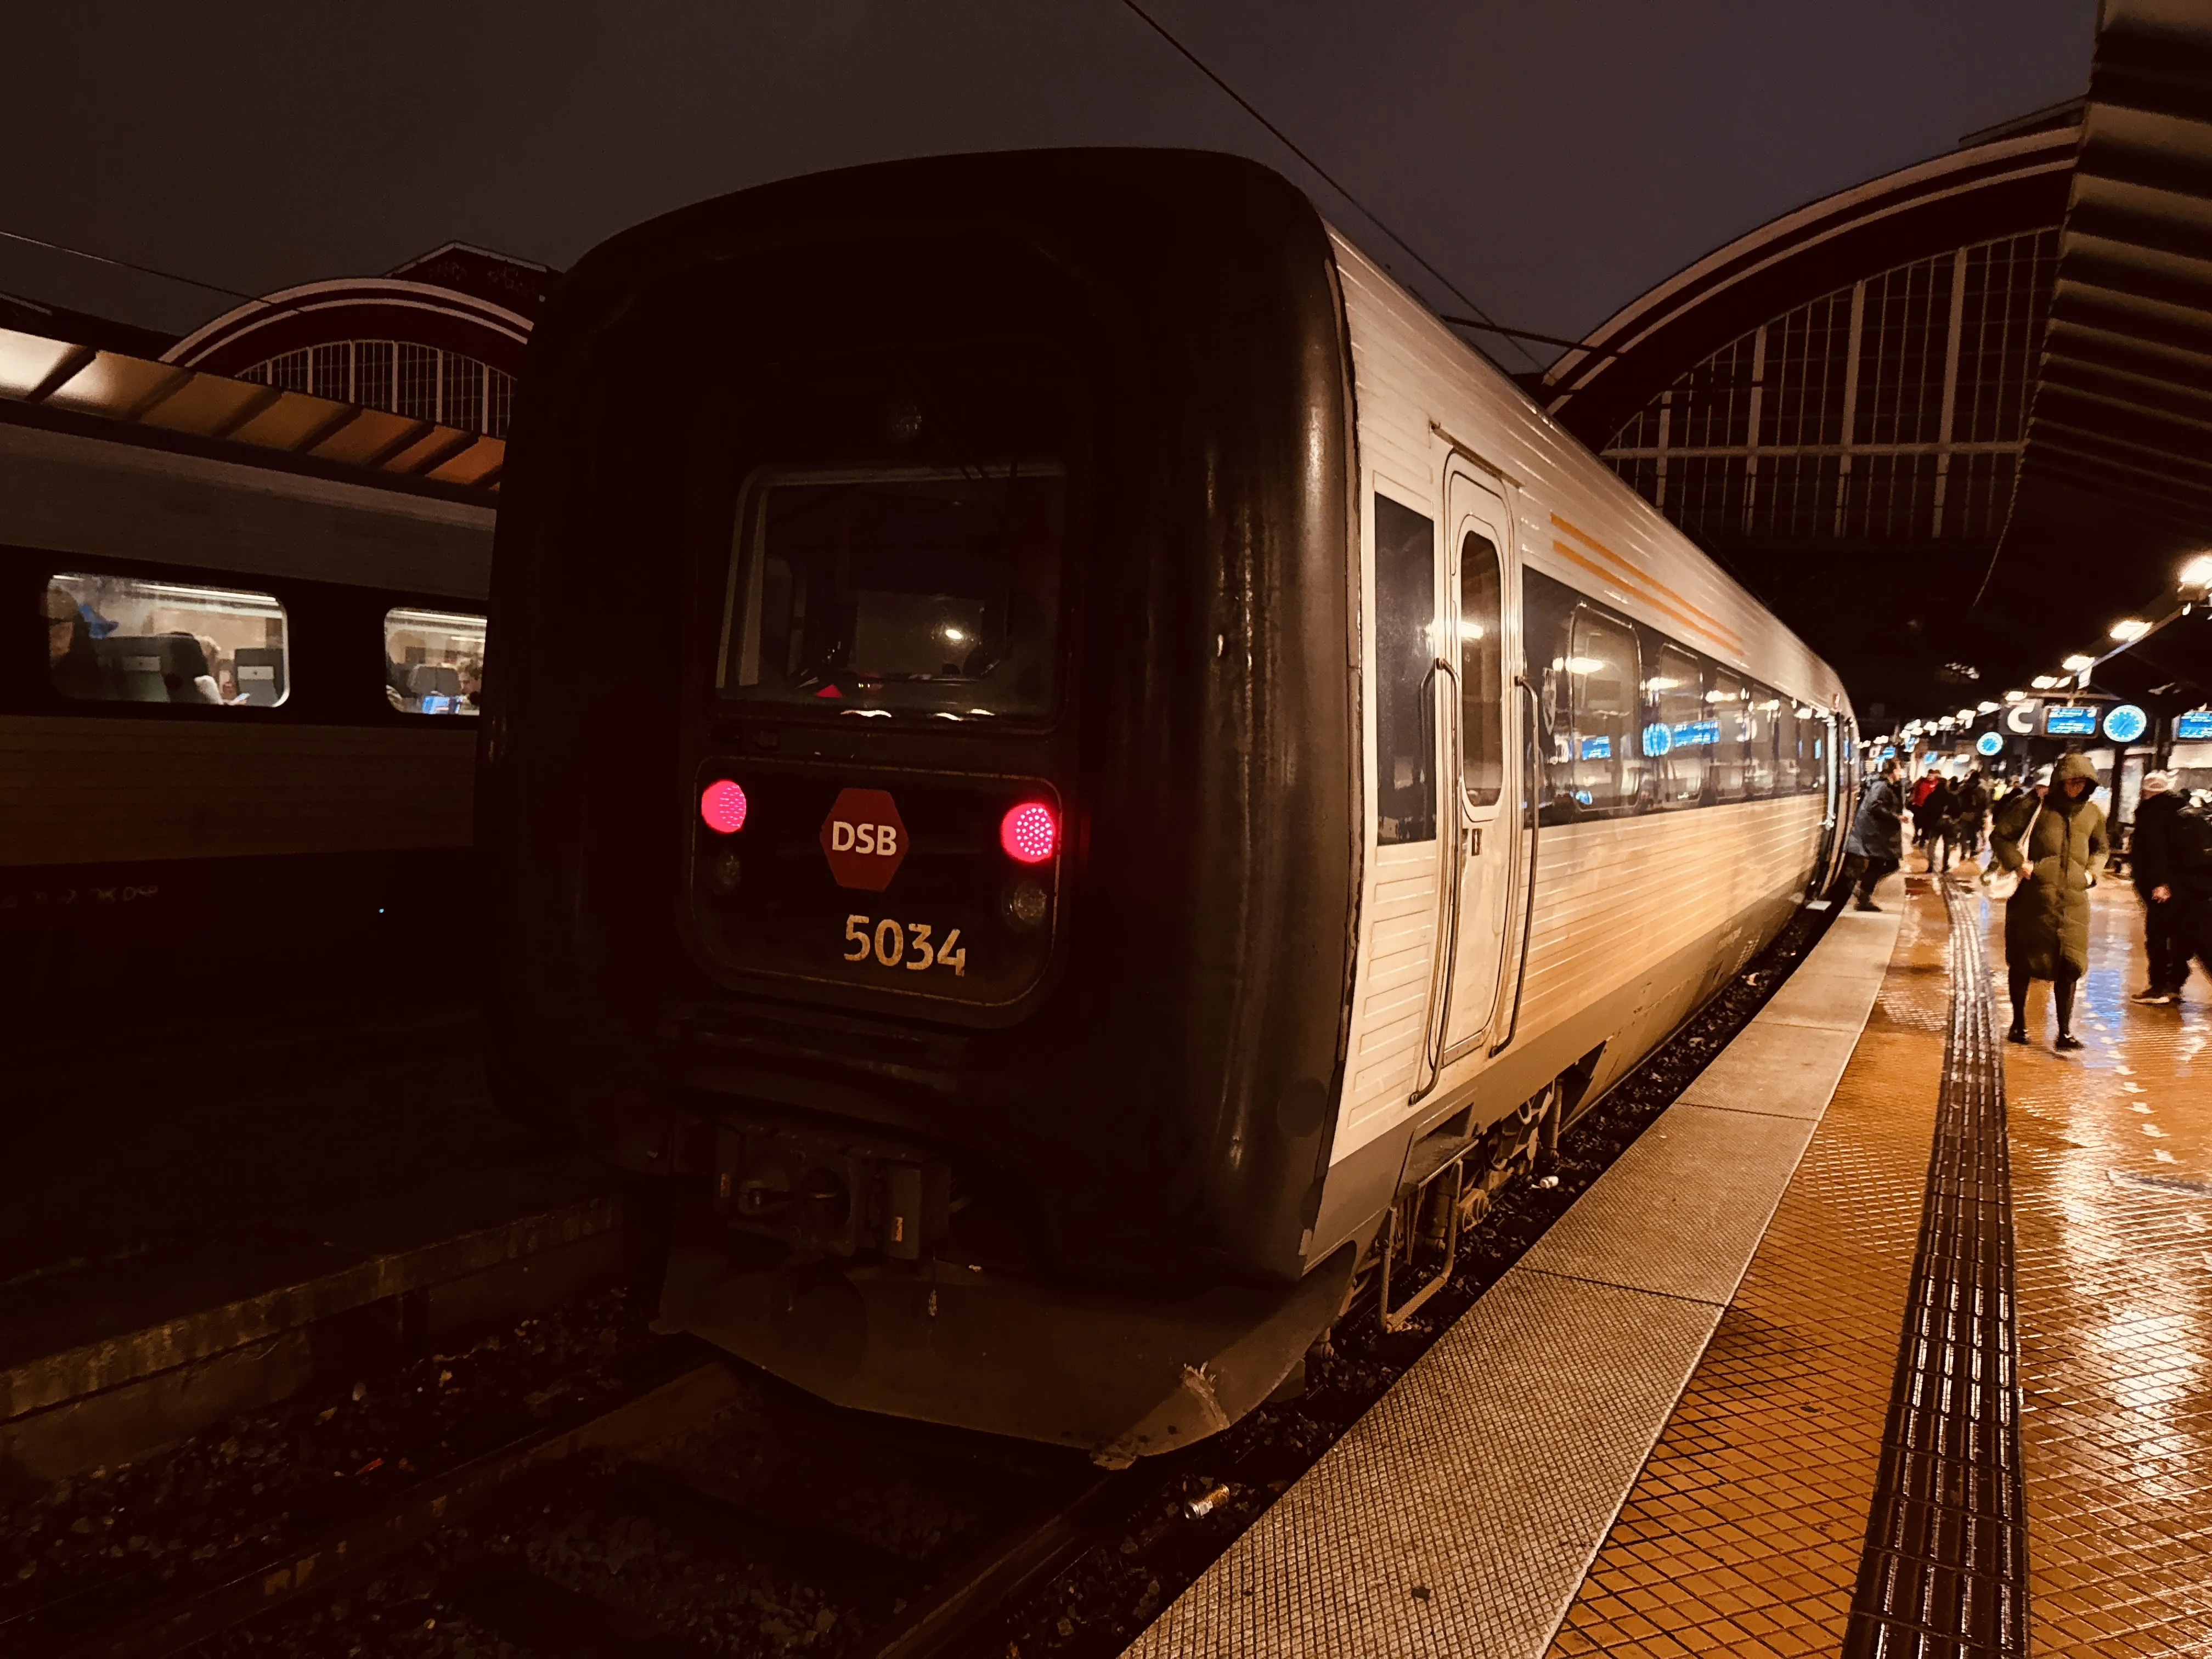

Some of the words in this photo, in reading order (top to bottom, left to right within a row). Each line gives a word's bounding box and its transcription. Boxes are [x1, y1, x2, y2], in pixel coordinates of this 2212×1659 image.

[2007, 704, 2034, 733] C
[832, 821, 897, 856] DSB
[843, 914, 966, 977] 5034
